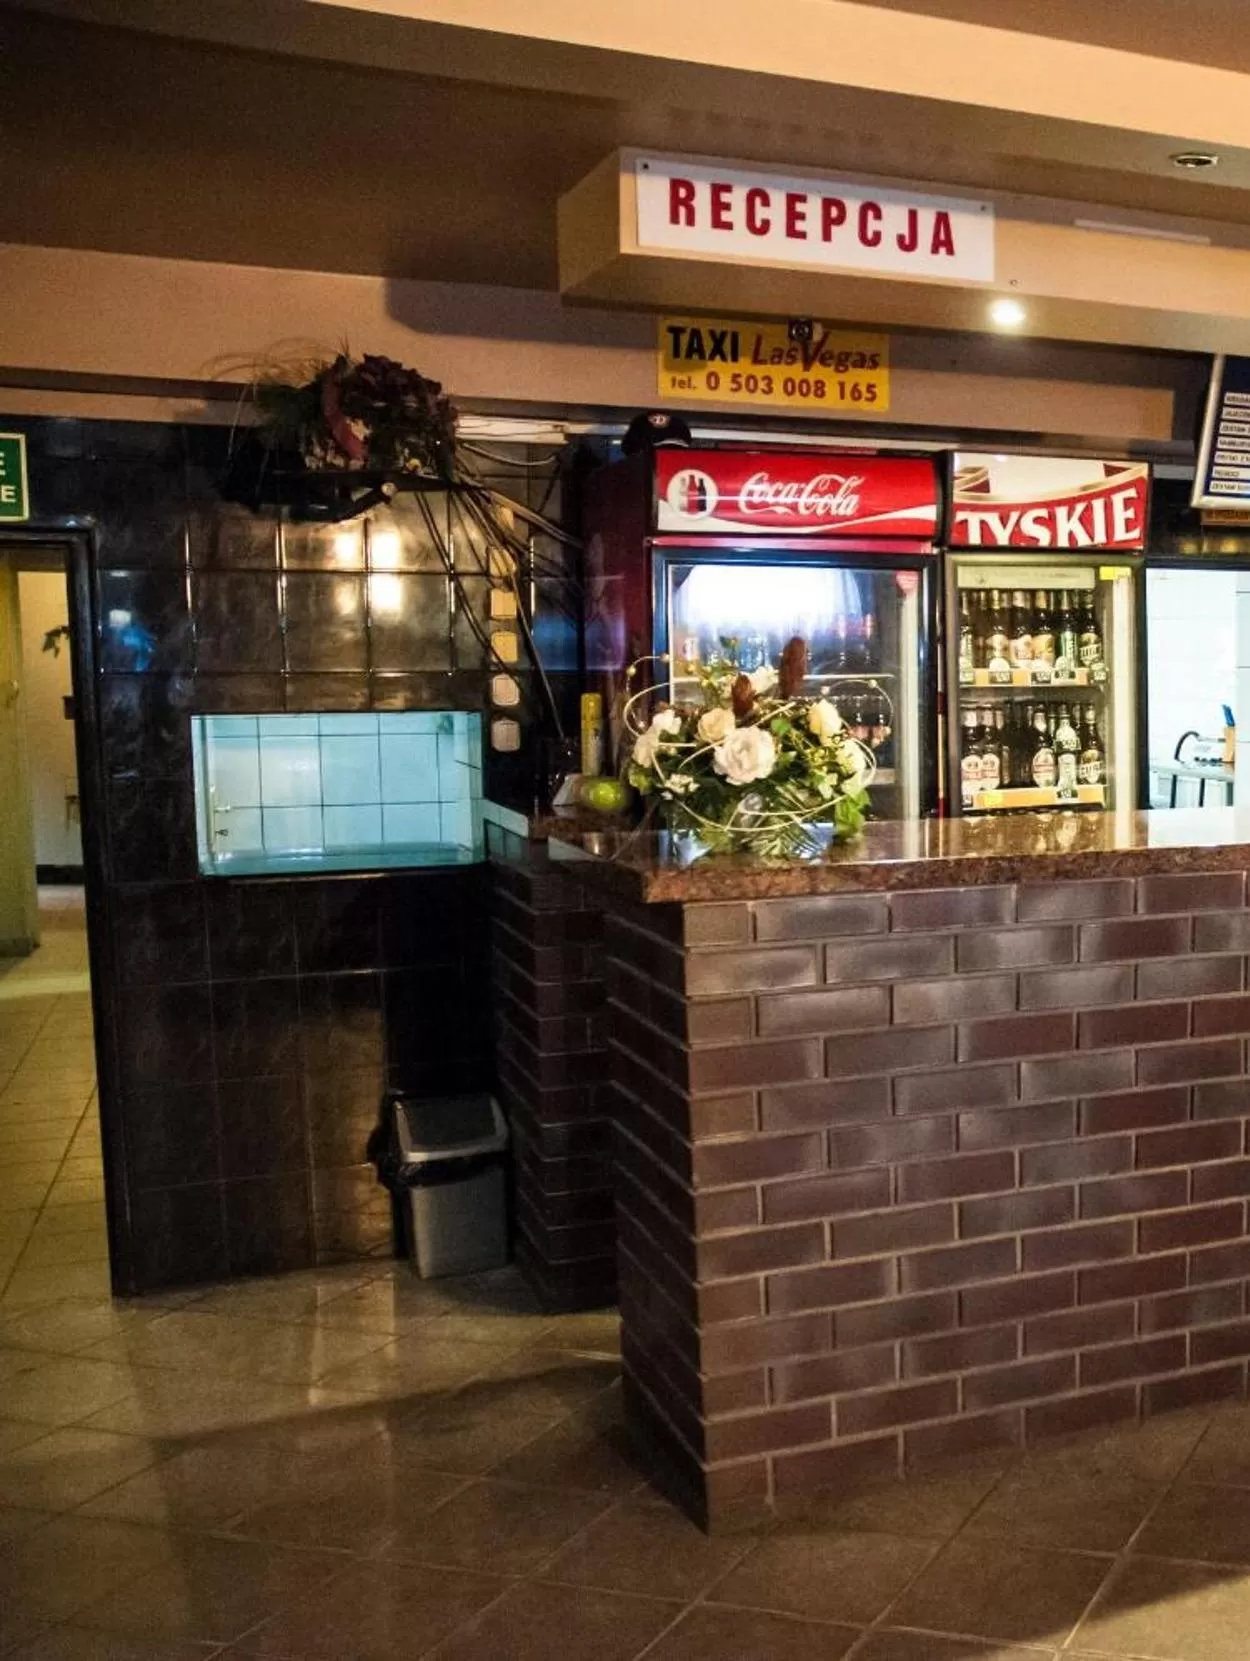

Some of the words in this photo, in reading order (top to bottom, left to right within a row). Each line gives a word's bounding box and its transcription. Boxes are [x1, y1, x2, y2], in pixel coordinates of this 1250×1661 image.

[668, 176, 956, 257] RECEPCJA
[667, 326, 740, 362] TAXI
[671, 376, 697, 390] tel.
[706, 371, 720, 391] 0
[729, 373, 774, 395] 503
[783, 377, 826, 399] 008
[837, 381, 878, 403] 165
[738, 471, 866, 518] Coca-Cola
[955, 487, 1142, 548] TYSKIE
